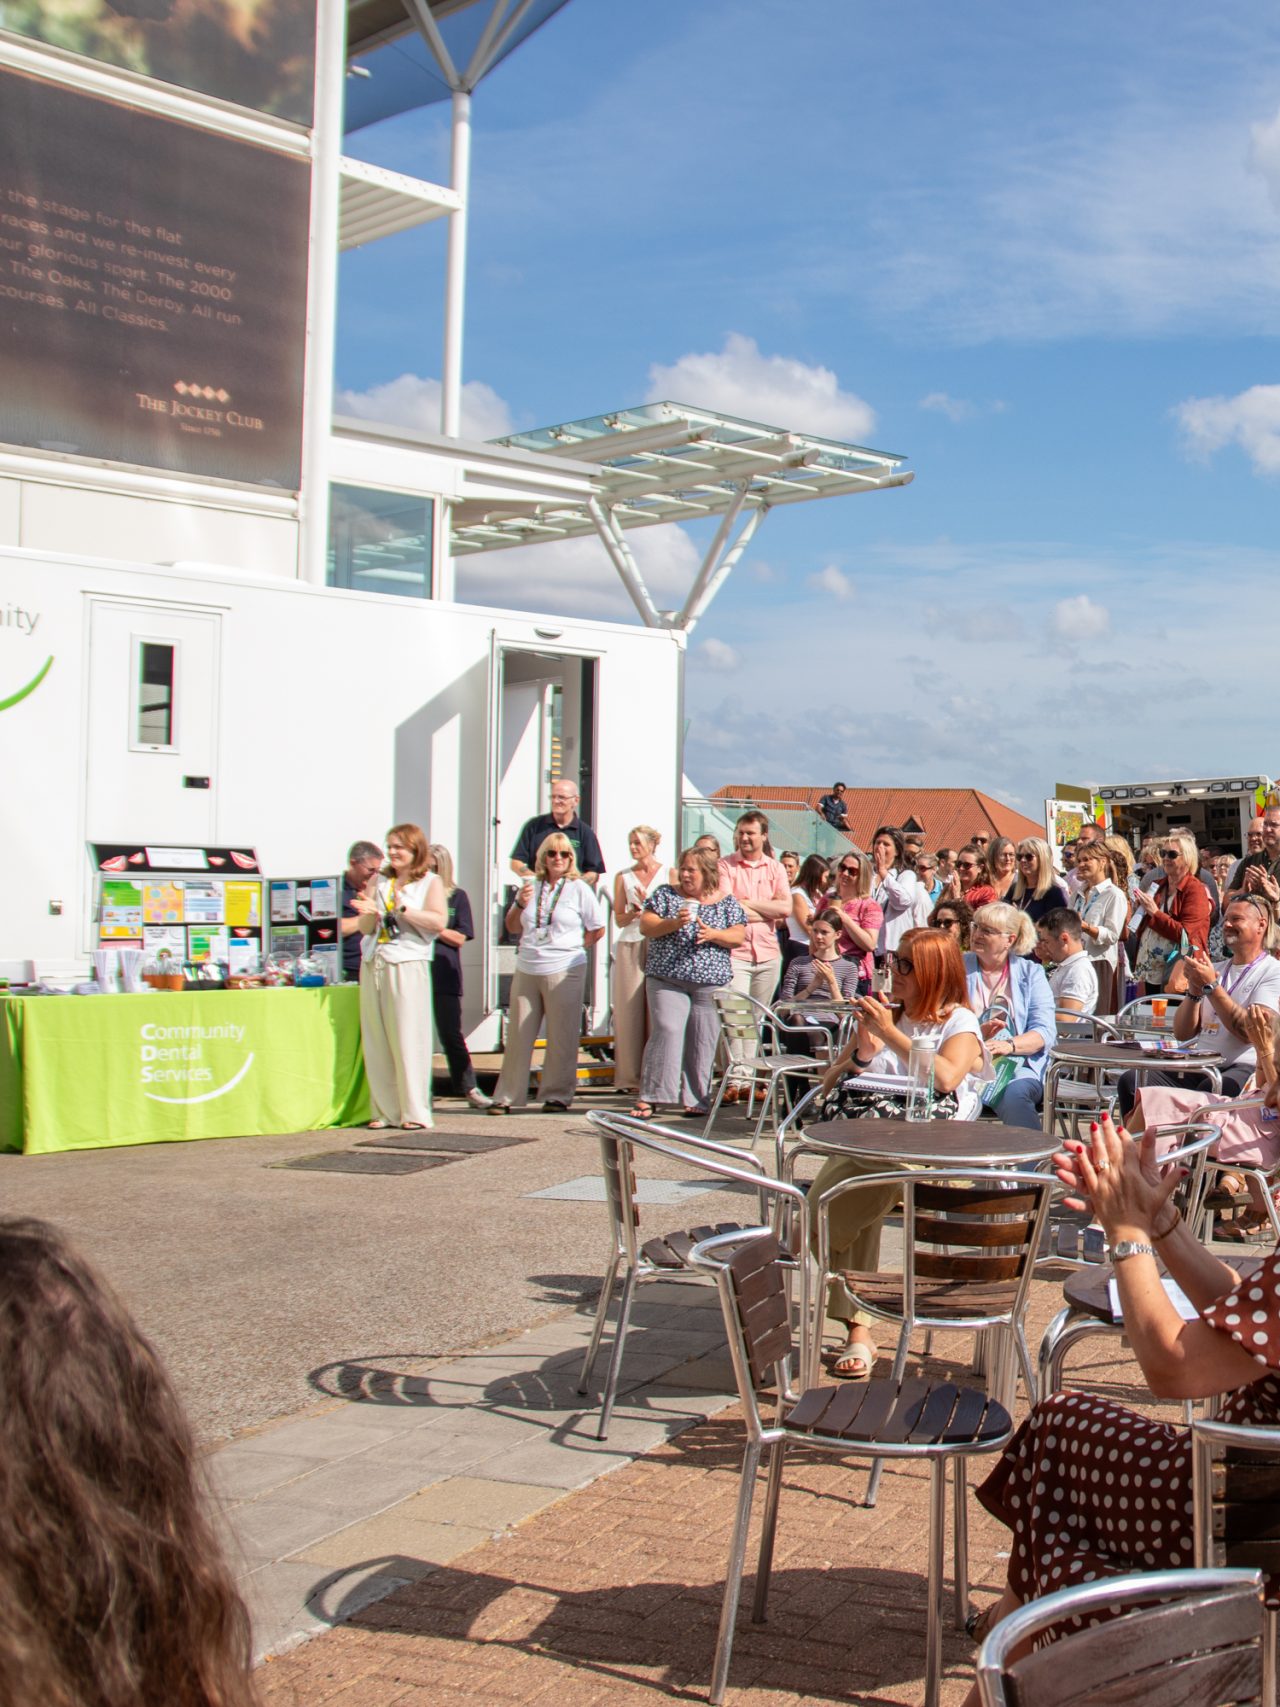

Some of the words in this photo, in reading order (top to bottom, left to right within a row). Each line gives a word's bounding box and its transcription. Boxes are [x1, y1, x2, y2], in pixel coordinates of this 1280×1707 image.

[42, 200, 91, 221] stage
[96, 210, 119, 229] for
[125, 219, 151, 238] the
[156, 226, 183, 246] flat
[1, 214, 49, 235] races
[54, 226, 87, 244] and
[92, 235, 116, 251] we
[194, 261, 237, 282] every
[28, 243, 98, 270] glorious
[156, 271, 186, 290] The
[190, 280, 233, 301] 2000
[10, 260, 44, 280] The
[102, 281, 130, 301] The
[192, 303, 212, 319] All
[216, 311, 242, 325] run
[75, 299, 97, 316] All
[136, 392, 168, 413] THE
[170, 400, 223, 422] JOCKEY
[226, 410, 264, 431] CLUB
[0, 602, 41, 636] ity
[140, 1021, 246, 1043] Community
[141, 1043, 202, 1061] Dental
[140, 1065, 213, 1083] Services
